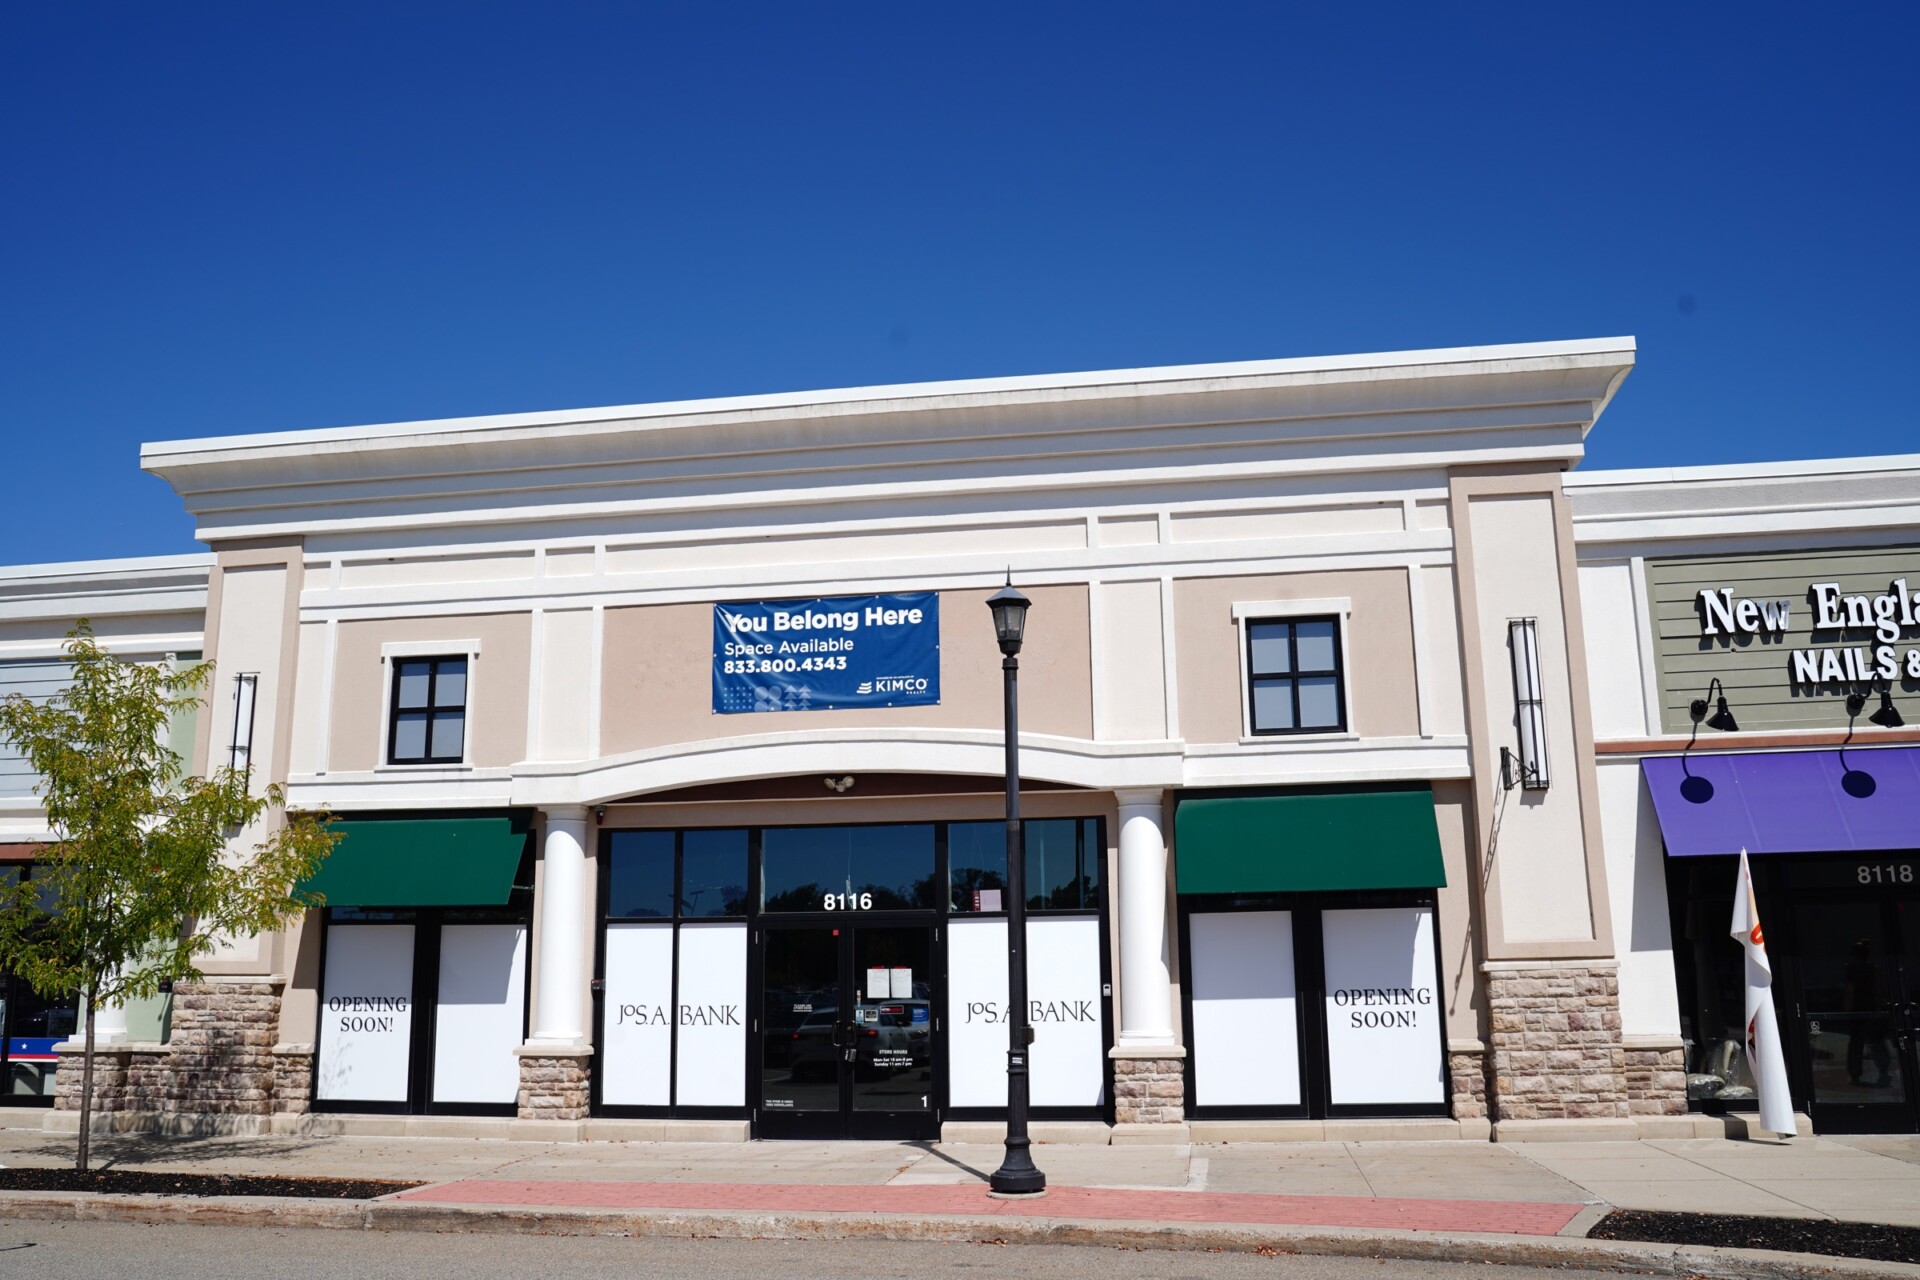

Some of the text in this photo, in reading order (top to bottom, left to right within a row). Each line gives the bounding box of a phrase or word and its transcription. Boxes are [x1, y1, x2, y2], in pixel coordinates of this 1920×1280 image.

[725, 606, 923, 633] You Belong Here
[1699, 587, 1791, 635] New
[724, 637, 854, 658] Space Available
[724, 656, 847, 674] 833.800.4343
[1792, 646, 1898, 682] NAILS
[876, 678, 927, 692] KIMCO
[1857, 864, 1914, 884] 8118
[823, 893, 872, 911] 8116
[329, 997, 407, 1012] OPENING
[1334, 988, 1431, 1006] OPENING
[651, 1005, 670, 1025] A.
[680, 1004, 741, 1025] BANK
[1030, 1000, 1096, 1023] BANK
[1351, 1011, 1417, 1028] SOON!
[340, 1017, 394, 1032] SOON!
[921, 1095, 927, 1108] 1
